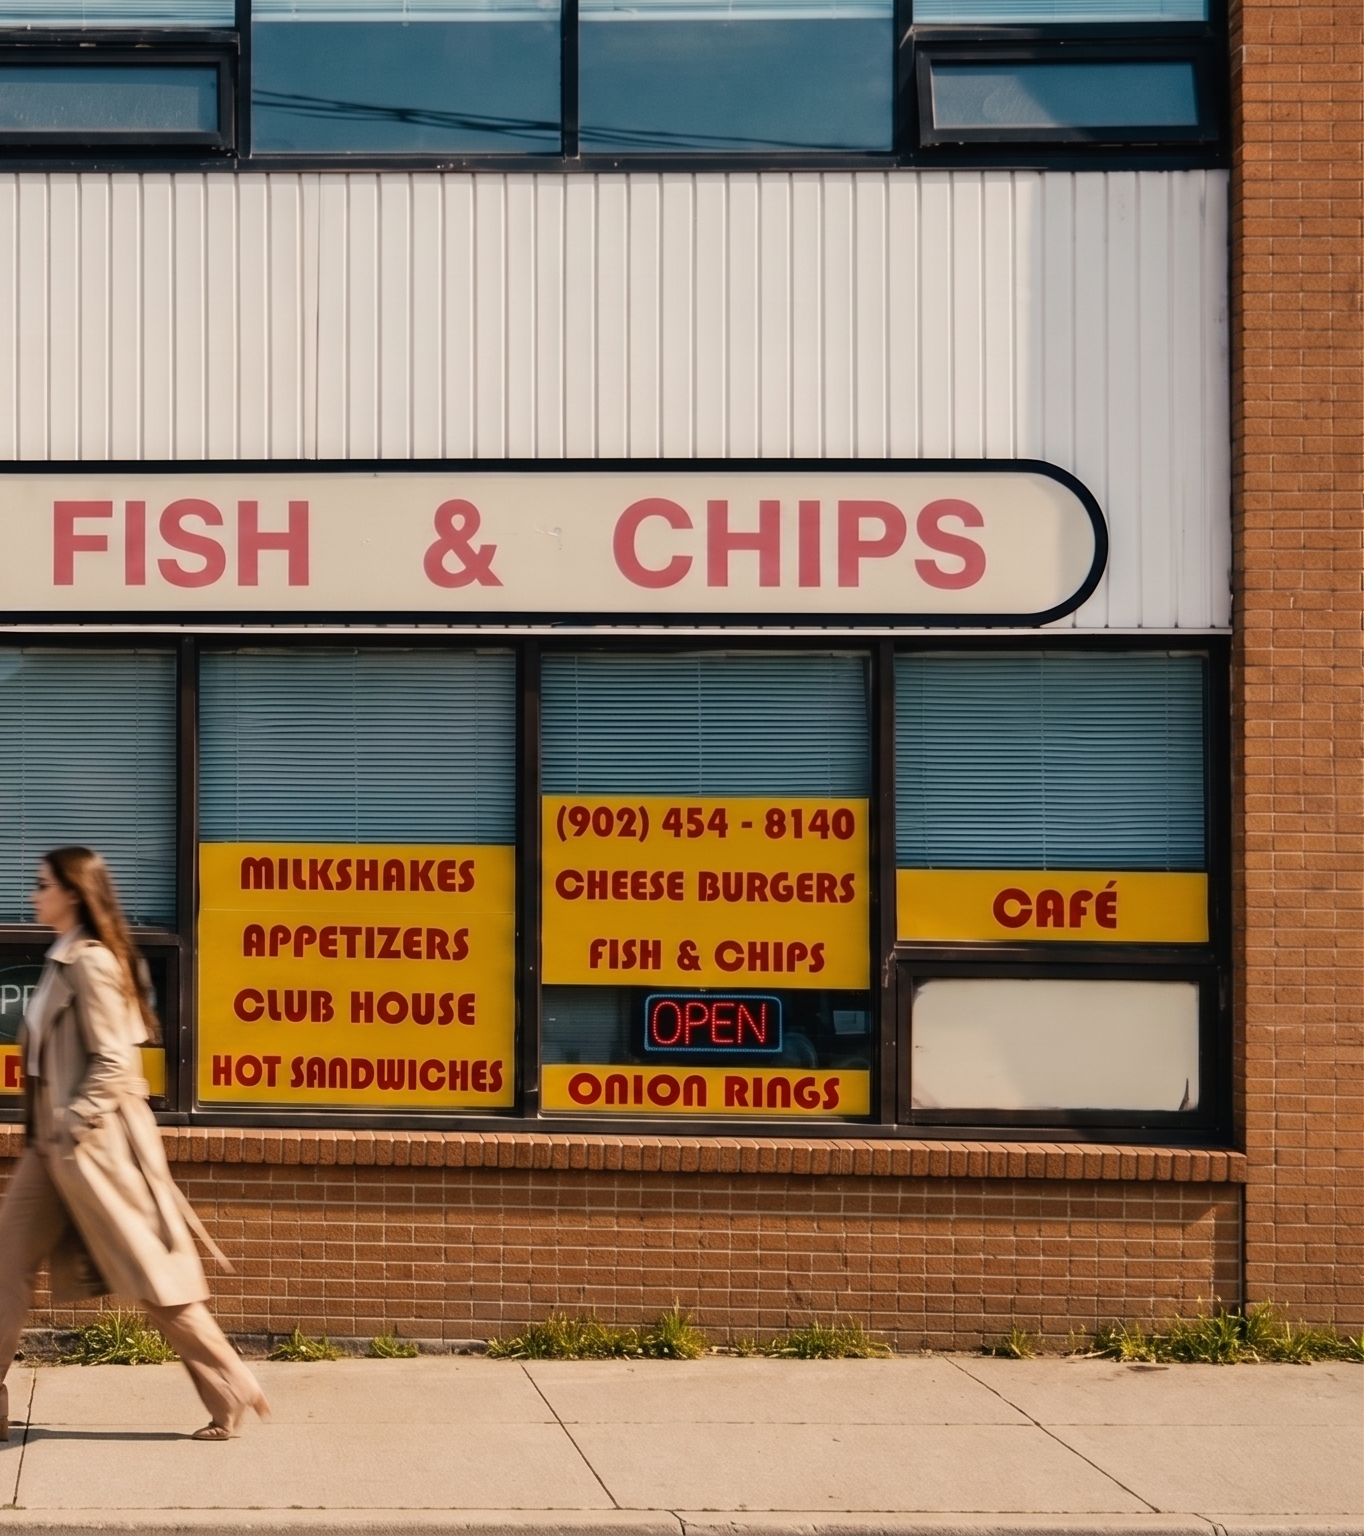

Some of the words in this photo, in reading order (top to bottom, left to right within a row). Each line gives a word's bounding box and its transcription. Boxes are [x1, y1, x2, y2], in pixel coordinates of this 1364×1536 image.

[53, 498, 310, 589] FISH
[423, 498, 503, 589] &
[612, 497, 988, 591] CHIPS
[556, 804, 650, 843] (902)
[661, 806, 729, 839] 454
[740, 820, 753, 829] -
[764, 807, 856, 841] 8140
[240, 856, 475, 893] MILKSHAKES
[554, 868, 685, 902] CHEESE
[697, 870, 856, 904] BURGERS
[992, 880, 1118, 930] CAFÉ
[242, 923, 470, 962] APPETIZERS
[589, 938, 662, 971] FISH
[676, 939, 702, 972] &
[714, 939, 826, 974] CHIPS
[233, 987, 335, 1023] CLUB
[350, 990, 476, 1026] HOUSE
[652, 1000, 767, 1045] OPEN
[212, 1054, 282, 1088] HOT
[290, 1055, 504, 1093] SANDWICHES
[568, 1072, 707, 1108] ONION
[723, 1074, 840, 1110] RINGS
